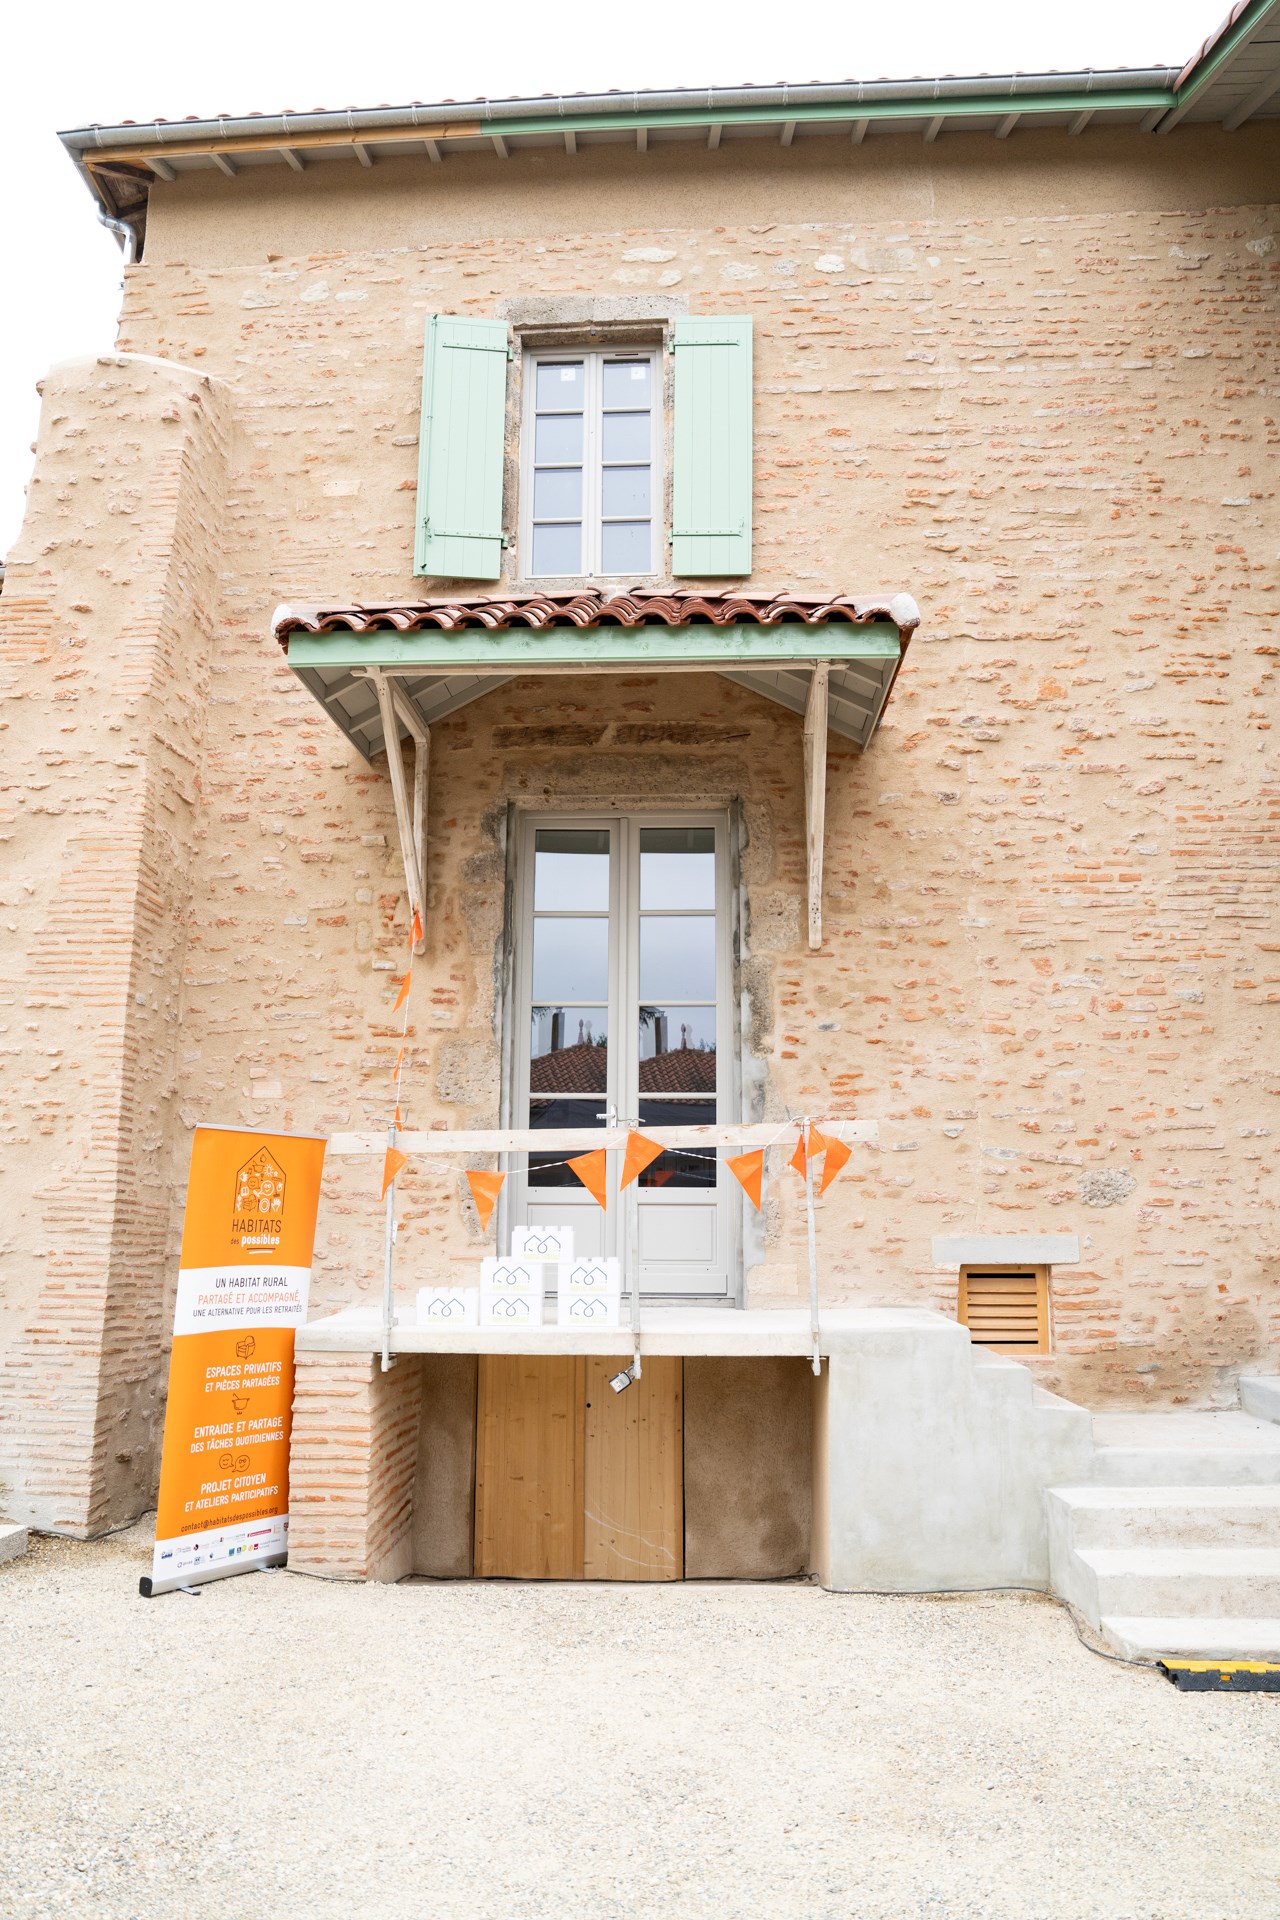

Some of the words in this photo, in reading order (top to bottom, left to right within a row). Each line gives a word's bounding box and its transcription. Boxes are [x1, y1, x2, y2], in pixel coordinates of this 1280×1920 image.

[231, 1219, 282, 1233] HABITATS
[241, 1234, 280, 1247] possibles
[215, 1278, 226, 1288] UN
[228, 1277, 261, 1288] HABITAT
[262, 1277, 288, 1287] RURAL
[198, 1292, 233, 1305] PARTAGÉ
[236, 1293, 246, 1304] ET
[192, 1309, 206, 1317] UNE
[207, 1307, 244, 1317] ALTERNATIVE
[245, 1306, 261, 1315] POUR
[262, 1306, 273, 1314] LES
[274, 1304, 302, 1313] RETRAITÉS
[206, 1364, 241, 1379] ESPACES
[243, 1361, 282, 1375] PRIVATIFS
[205, 1382, 214, 1393] ET
[215, 1379, 240, 1391] PIÈCES
[242, 1375, 280, 1389] PARTAGÉES
[194, 1422, 234, 1439] ENTRAIDE
[236, 1421, 246, 1432] ET
[248, 1416, 283, 1431] PARTAGE
[190, 1443, 204, 1454] DES
[206, 1437, 234, 1451] TÂCHES
[235, 1430, 284, 1446] QUOTIDIENNES
[200, 1479, 232, 1495] PROJET
[234, 1473, 267, 1489] CITOYEN
[184, 1501, 194, 1512] ET
[195, 1495, 229, 1510] ATELIERS
[230, 1485, 279, 1503] PARTICIPATIFS
[180, 1506, 279, 1532] contact@habitatsdespossibles.org
